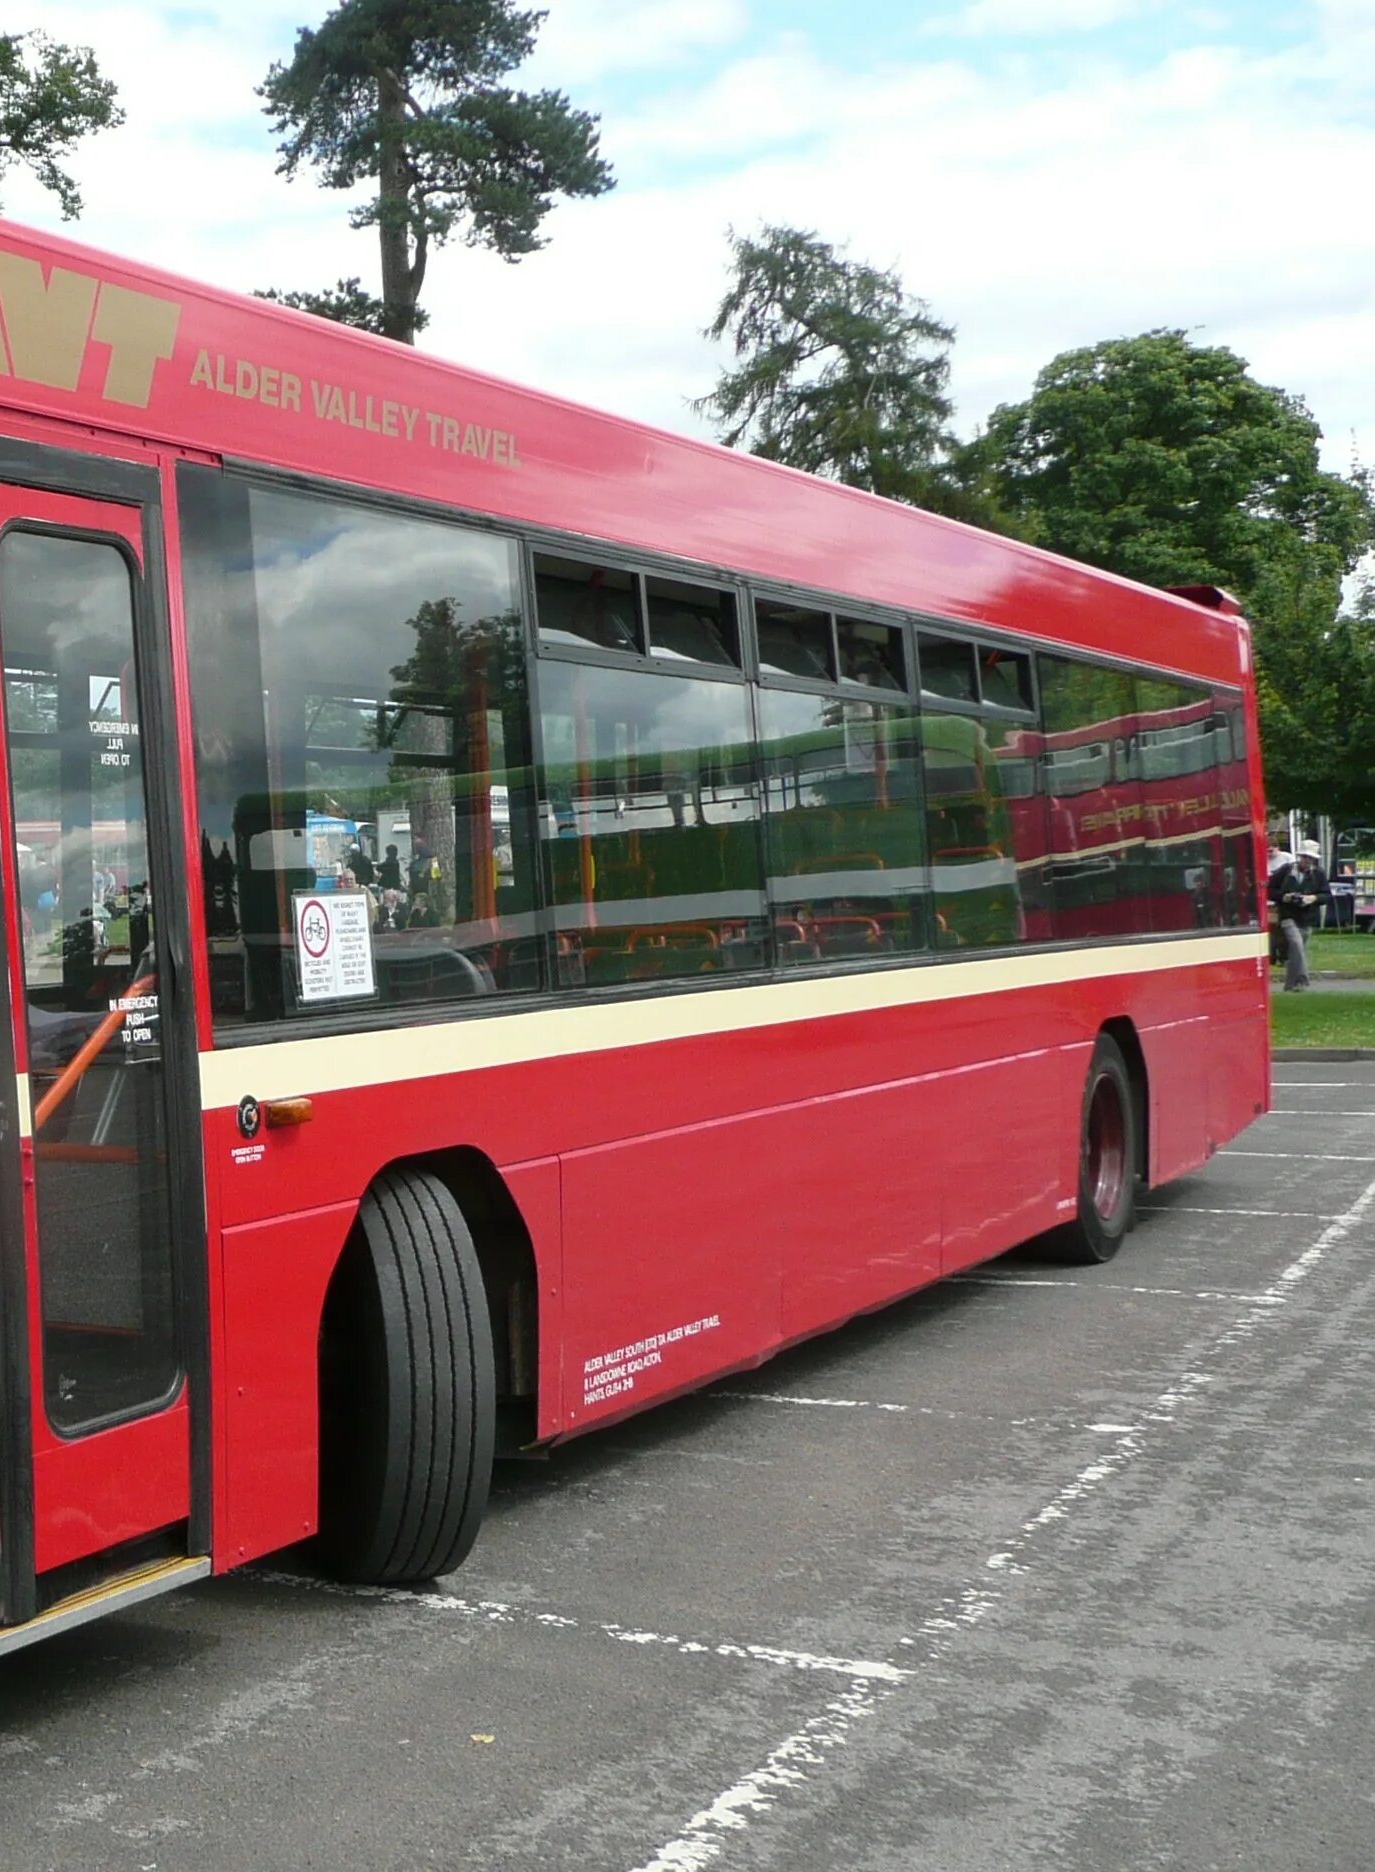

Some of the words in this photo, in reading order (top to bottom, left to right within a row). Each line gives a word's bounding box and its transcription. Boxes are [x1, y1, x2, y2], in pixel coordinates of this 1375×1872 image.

[189, 348, 302, 413] ALDER
[310, 379, 419, 443] VALLEY
[426, 411, 524, 469] TRAVEL
[126, 1012, 145, 1026] PUSH
[121, 1030, 131, 1043] TO
[133, 1027, 152, 1041] OPEN
